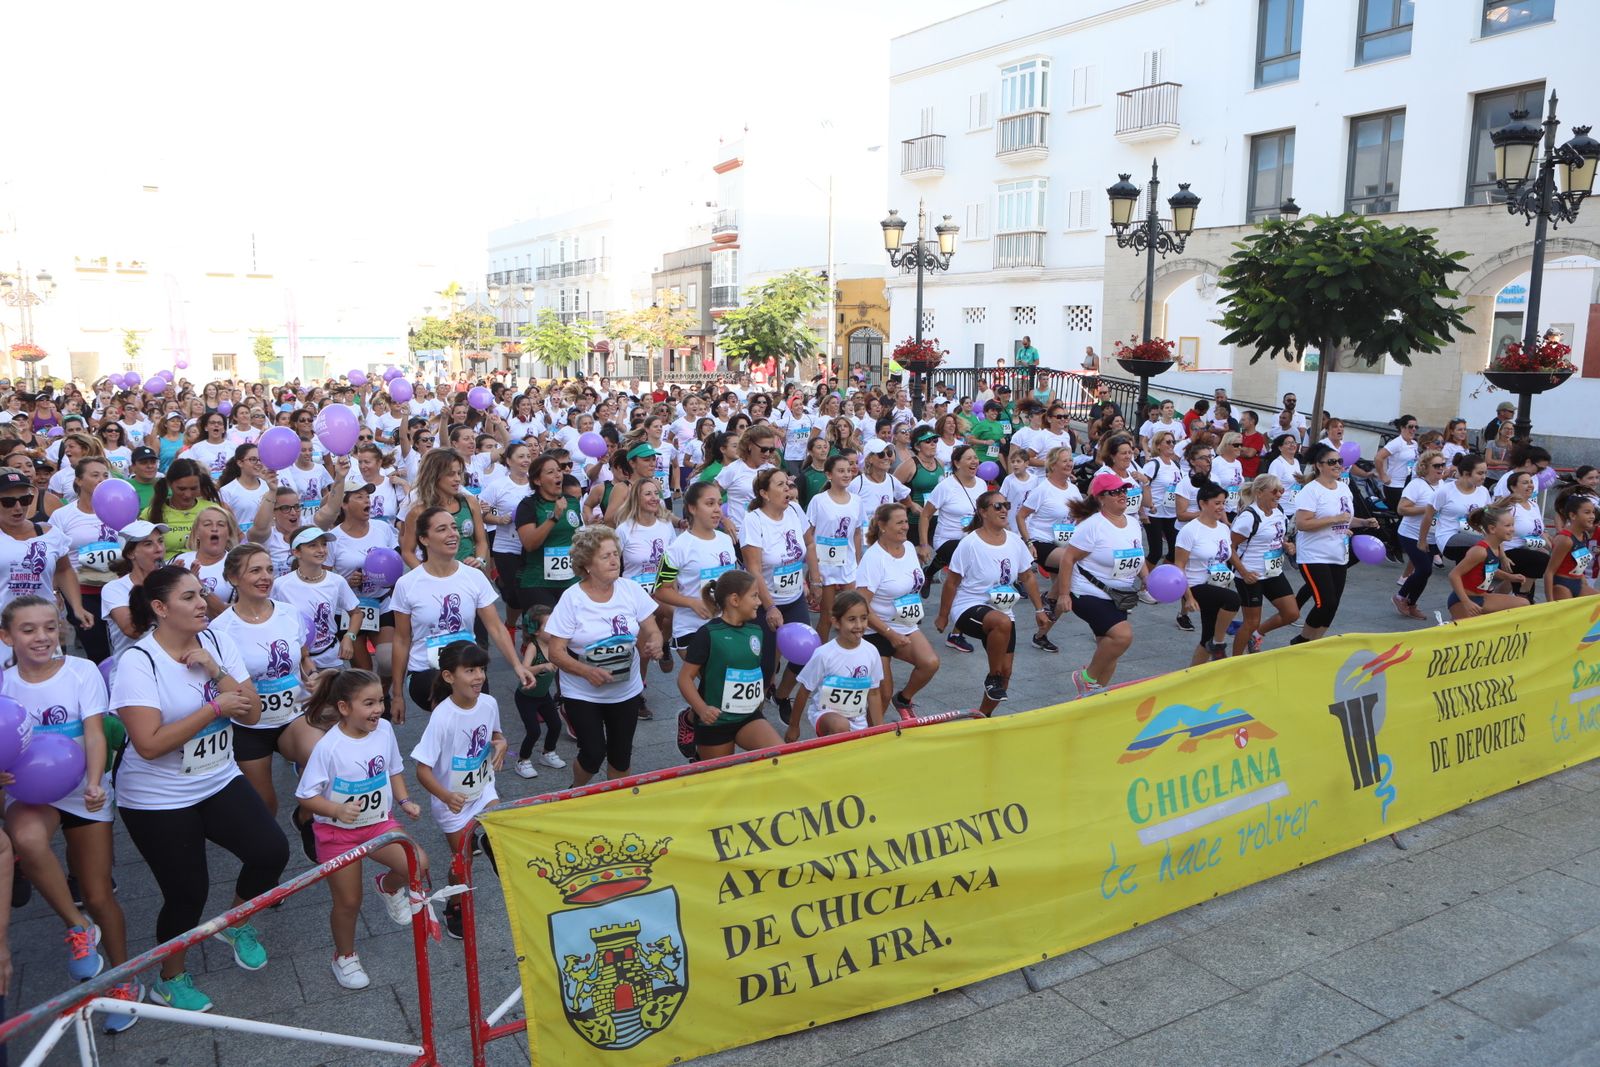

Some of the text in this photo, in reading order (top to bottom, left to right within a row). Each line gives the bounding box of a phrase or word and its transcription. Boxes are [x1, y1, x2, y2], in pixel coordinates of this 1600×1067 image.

[86, 550, 117, 565] 310
[828, 547, 836, 557] 6
[1119, 558, 1141, 570] 546
[780, 571, 800, 588] 547
[1212, 572, 1231, 582] 354
[900, 605, 921, 618] 548
[993, 592, 1015, 605] 544
[1427, 624, 1532, 679] DELEGACIÓN
[732, 681, 761, 700] 266
[829, 688, 864, 705] 575
[1432, 675, 1518, 722] MUNICIPAL
[193, 730, 228, 759] 410
[1429, 713, 1526, 773] DE DEPORTES
[462, 760, 488, 788] 412
[1127, 747, 1281, 824] CHICLANA
[707, 795, 877, 862] EXCMO.
[717, 803, 1029, 905] AYUNTAMIENTO
[1101, 799, 1320, 900] te hace volver
[721, 865, 1000, 960] DE CHICLANA
[736, 919, 952, 1005] DE LA FRA.
